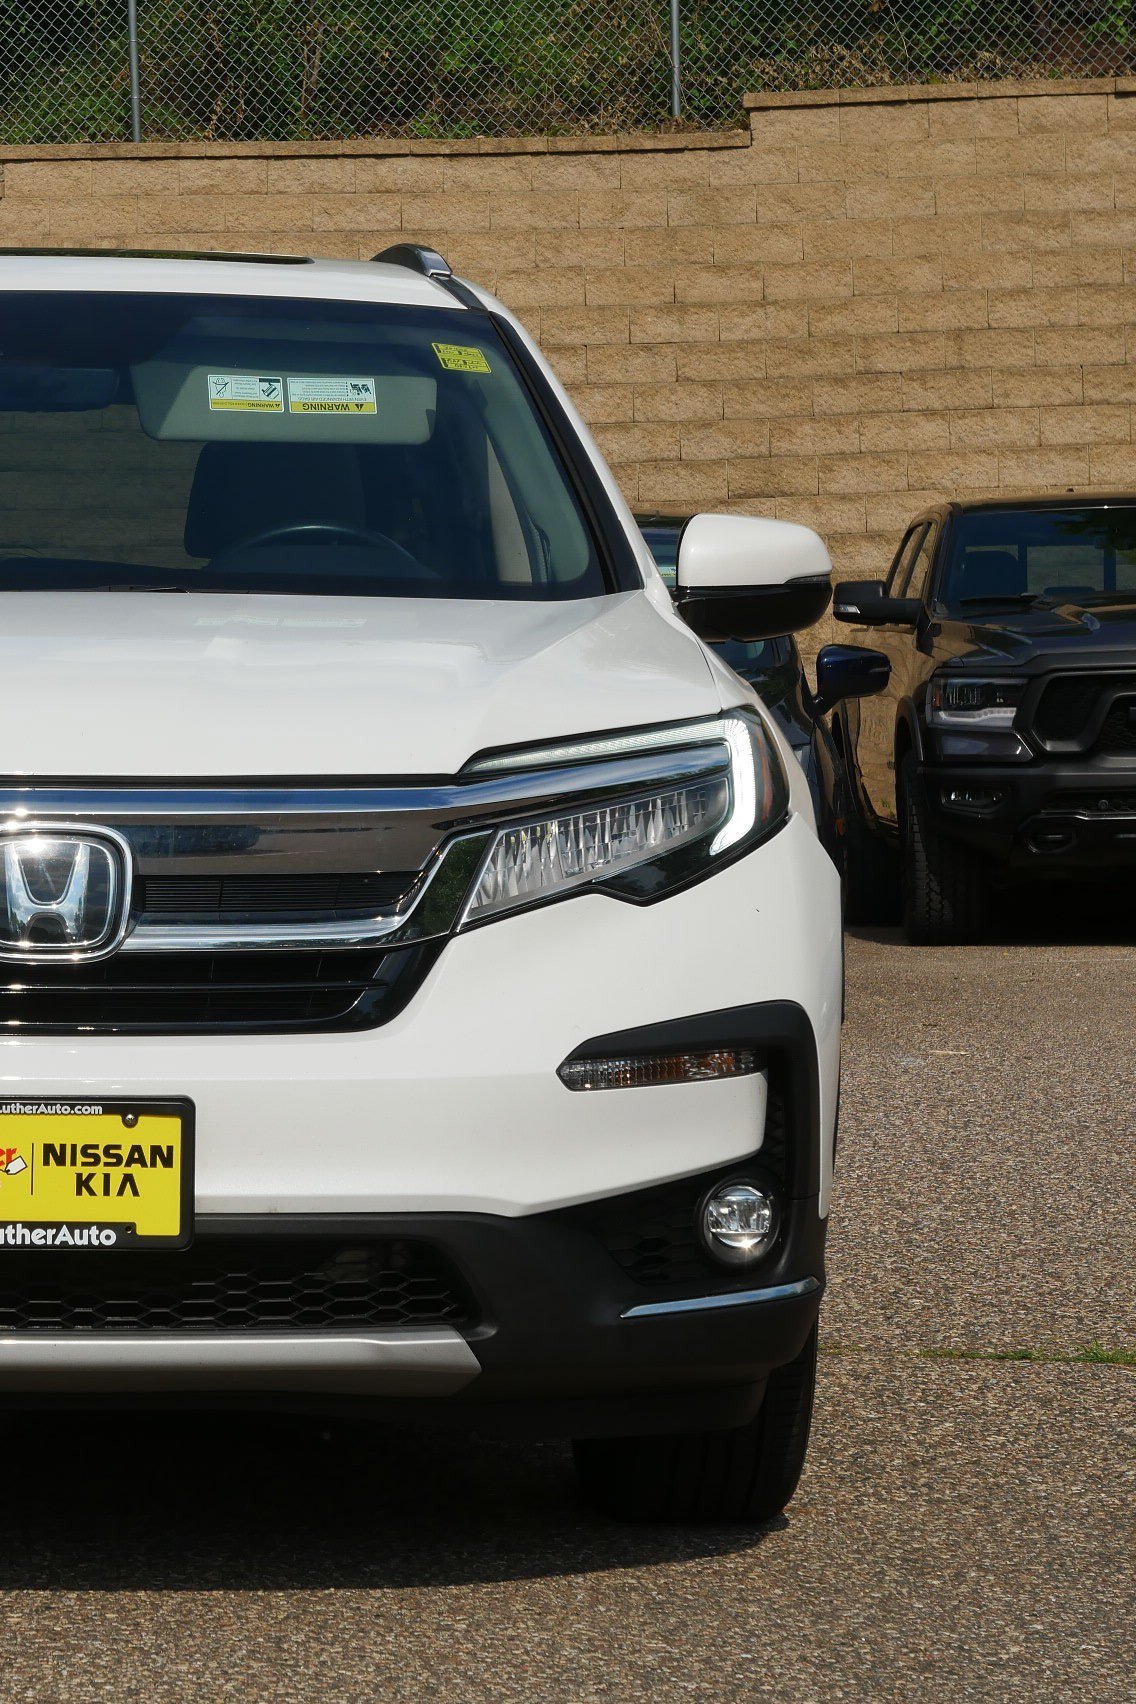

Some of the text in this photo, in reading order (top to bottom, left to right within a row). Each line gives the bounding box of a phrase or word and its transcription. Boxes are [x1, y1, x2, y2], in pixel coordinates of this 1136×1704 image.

[302, 403, 350, 411] WARNING
[42, 1143, 174, 1168] NISSAN
[75, 1172, 141, 1197] KIA
